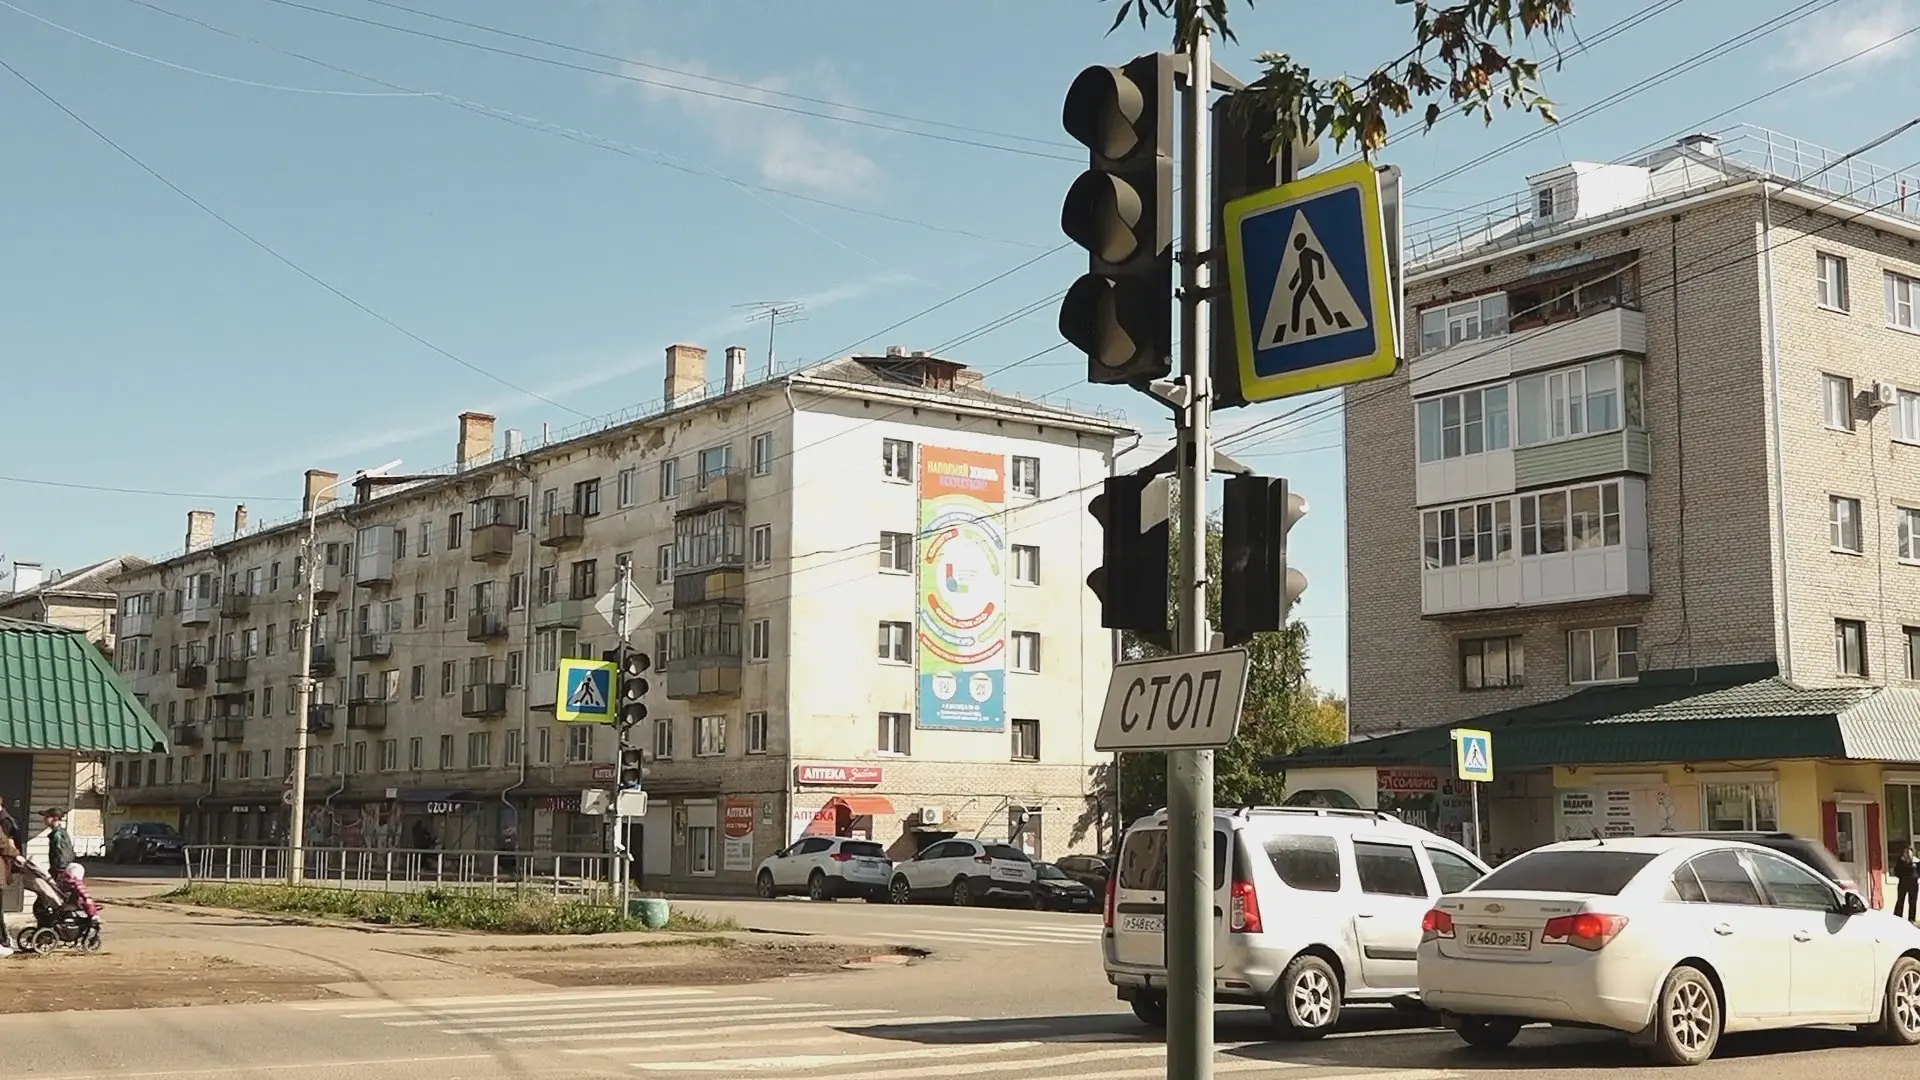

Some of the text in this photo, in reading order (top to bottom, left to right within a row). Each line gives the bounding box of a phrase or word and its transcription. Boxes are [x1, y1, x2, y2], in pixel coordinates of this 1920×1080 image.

[1121, 669, 1223, 733] СТОП
[804, 767, 847, 780] АПТЕКА
[726, 807, 752, 818] АПТЕКА
[793, 810, 834, 821] АПТЕКА
[1468, 931, 1527, 946] К460ОР 35
